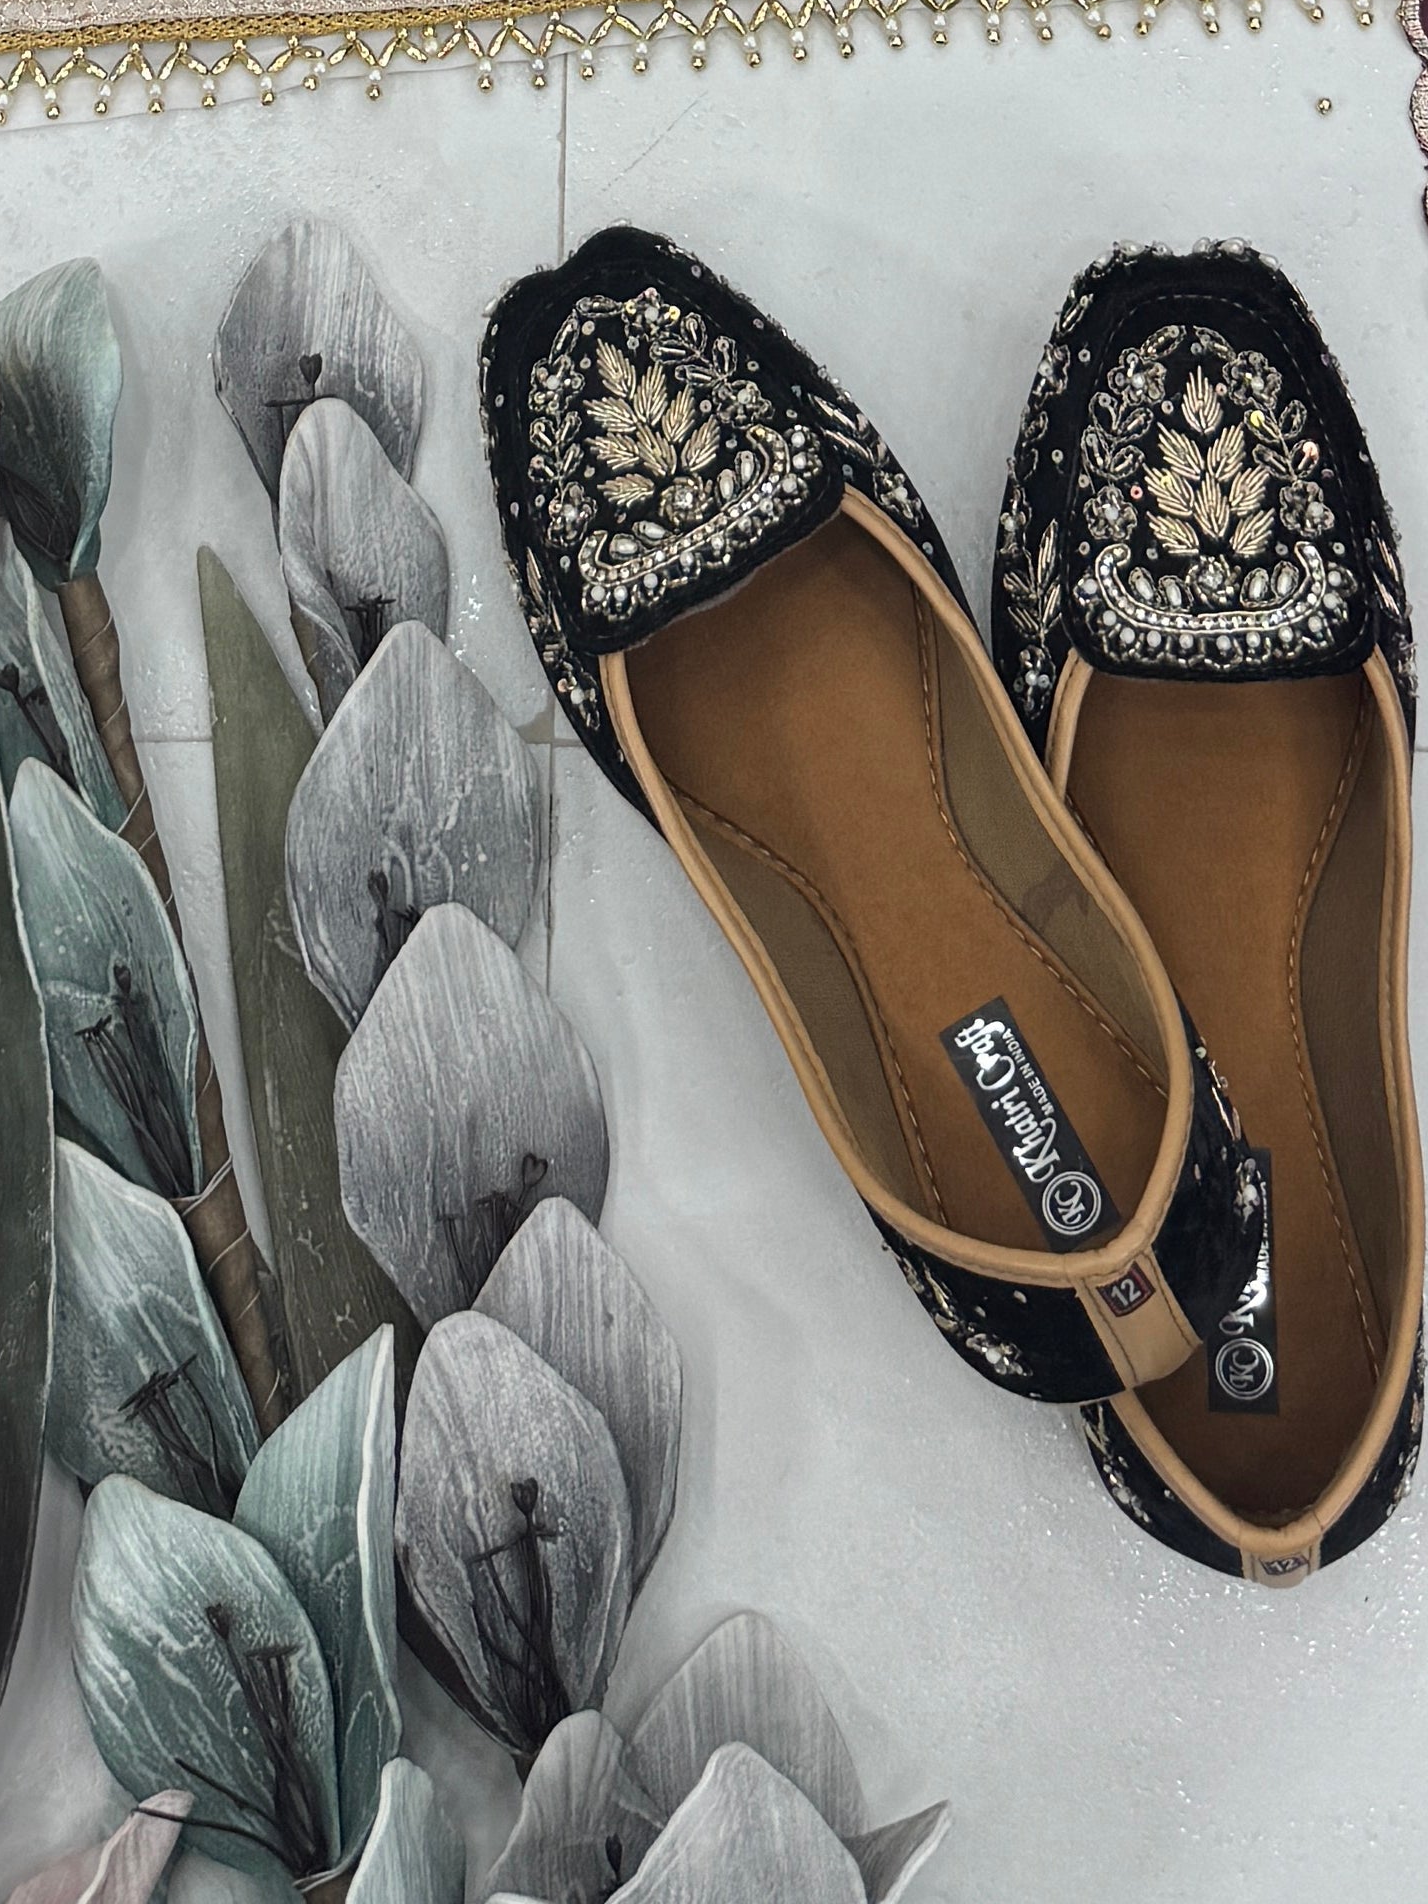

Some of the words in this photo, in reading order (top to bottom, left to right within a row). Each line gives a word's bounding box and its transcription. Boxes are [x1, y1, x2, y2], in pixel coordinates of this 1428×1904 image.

[954, 1018, 1016, 1091] Craft
[1002, 1027, 1026, 1064] INDIA
[1019, 1062, 1035, 1079] IN
[1028, 1076, 1055, 1116] MADE
[990, 1085, 1061, 1184] Khatri
[1054, 1180, 1086, 1225] KC
[1111, 1278, 1142, 1307] 12
[1229, 1349, 1260, 1390] KC
